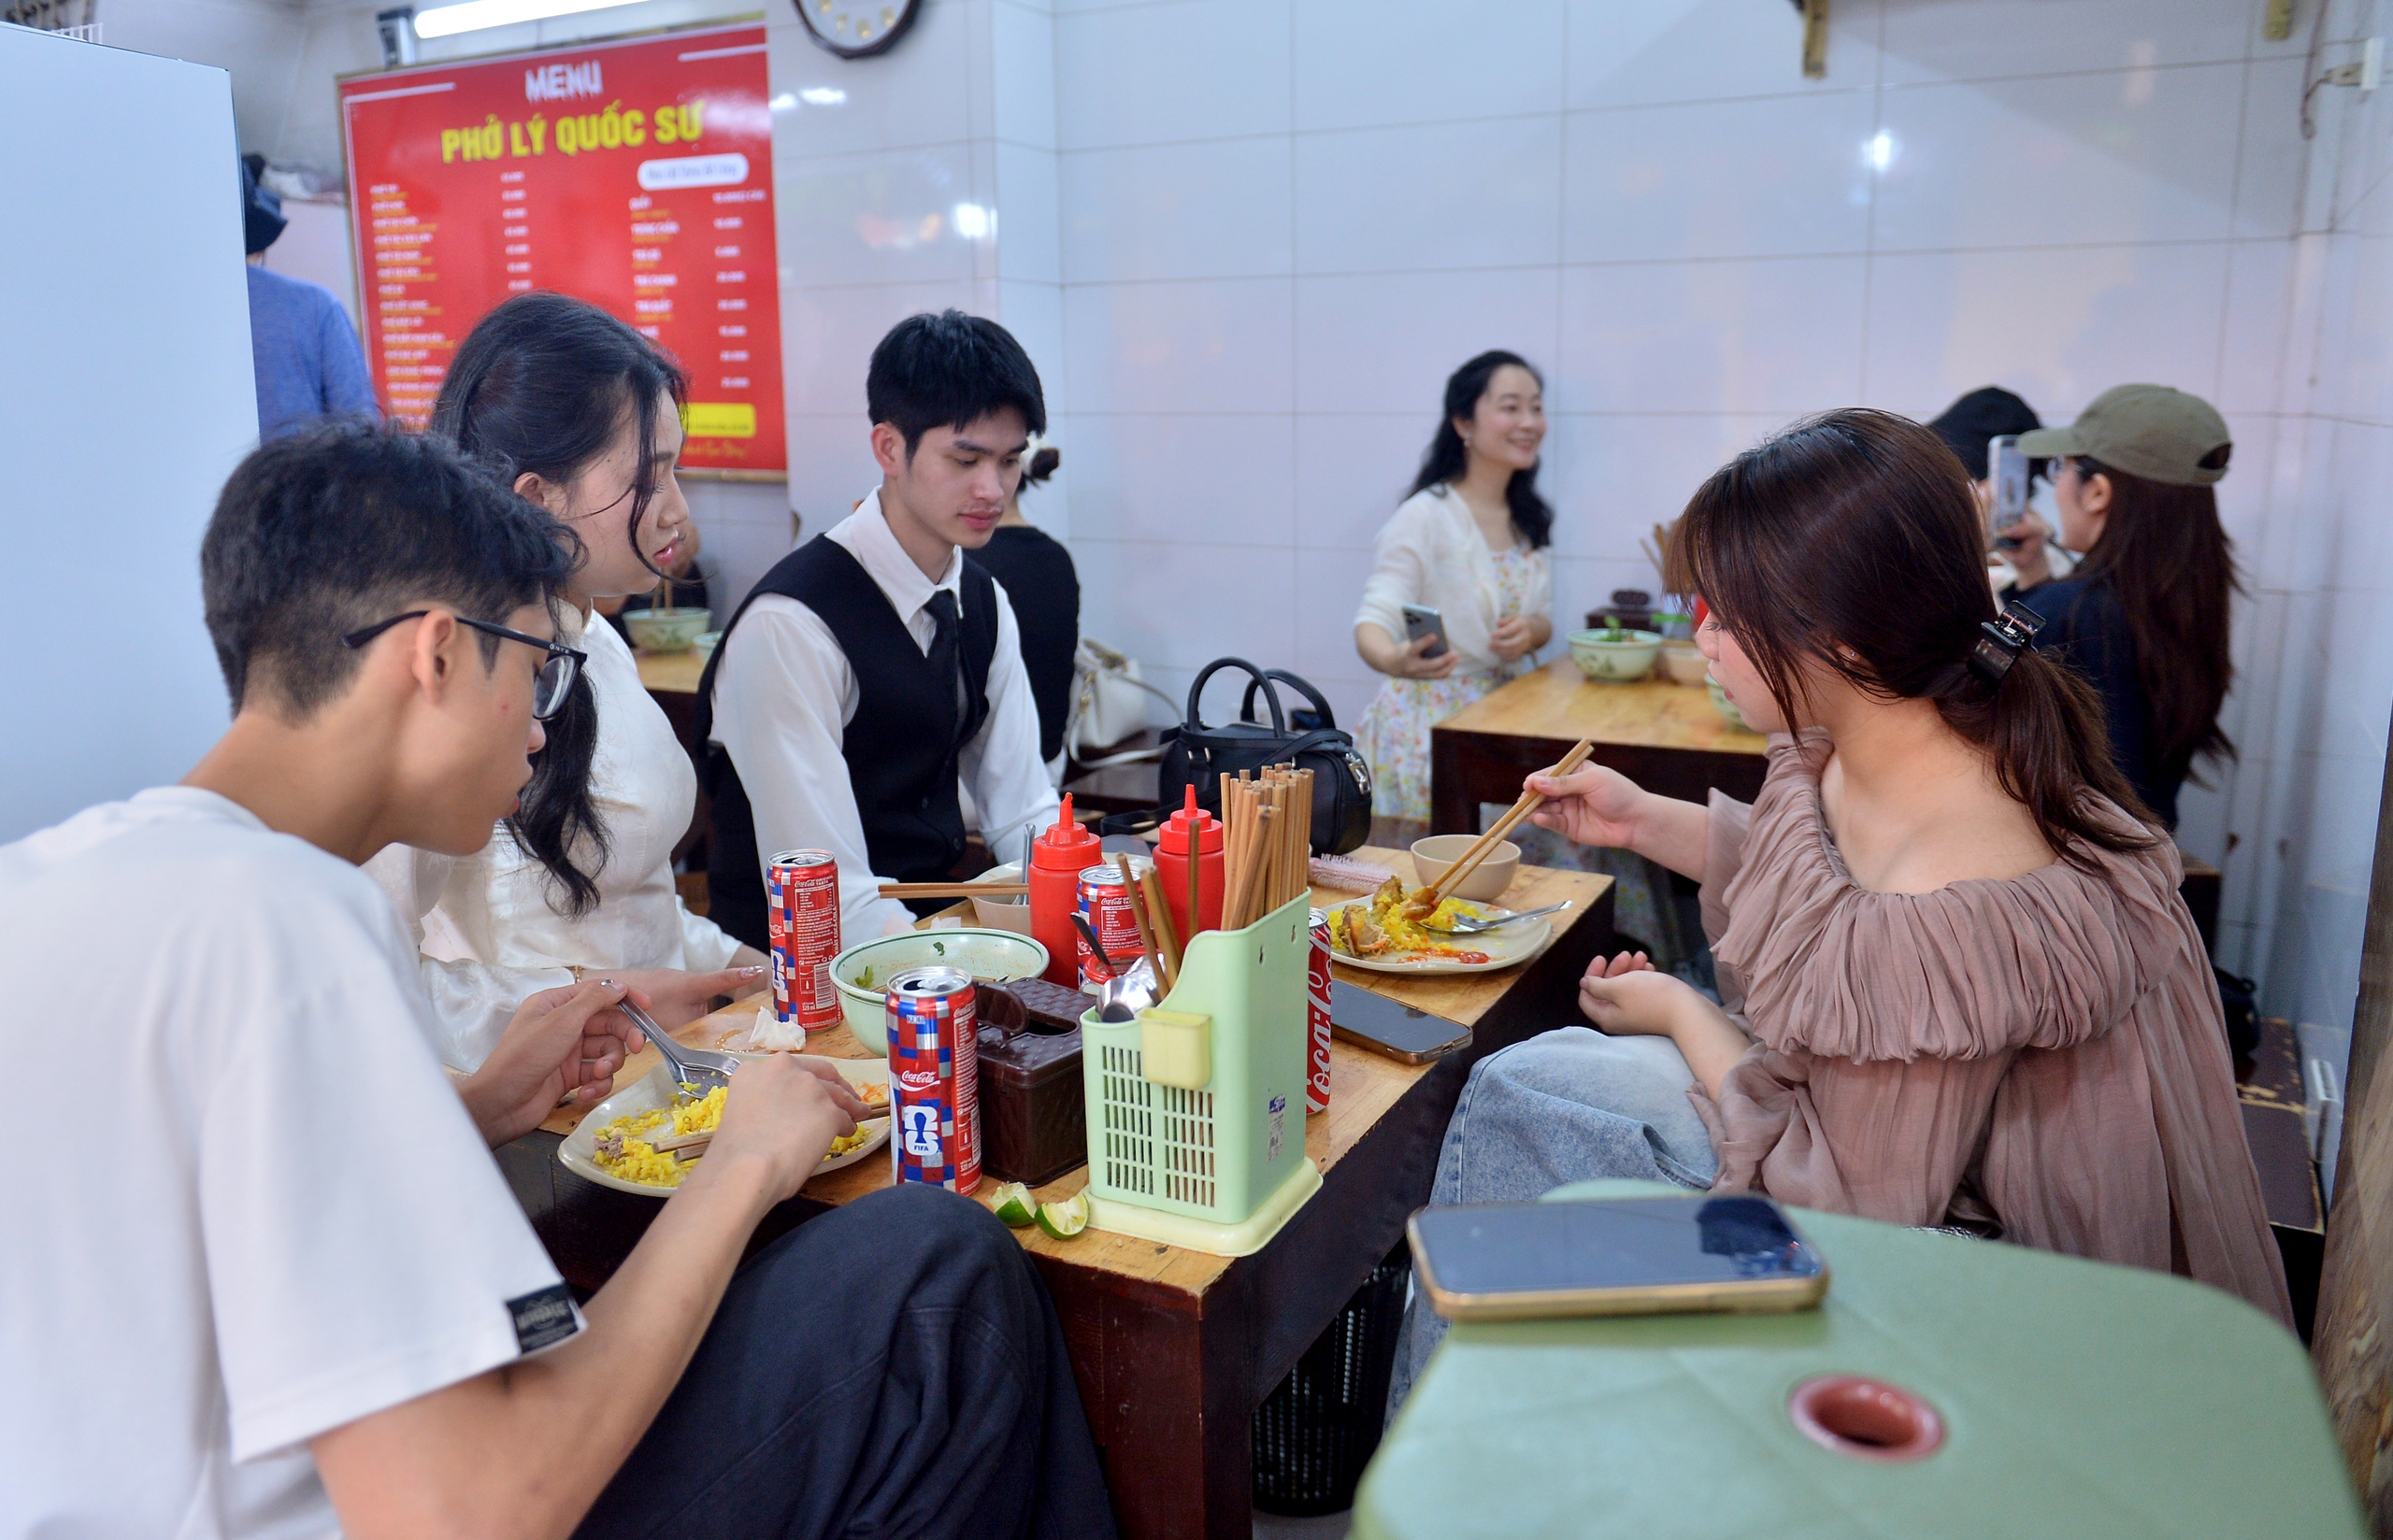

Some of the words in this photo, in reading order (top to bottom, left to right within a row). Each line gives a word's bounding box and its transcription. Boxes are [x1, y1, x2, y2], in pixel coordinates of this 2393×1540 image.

[525, 60, 603, 100] MENU
[440, 113, 504, 164] PHỞ
[509, 113, 547, 157] LÝ
[555, 99, 646, 156] QUỐC
[902, 1070, 937, 1083] Coca-Cola
